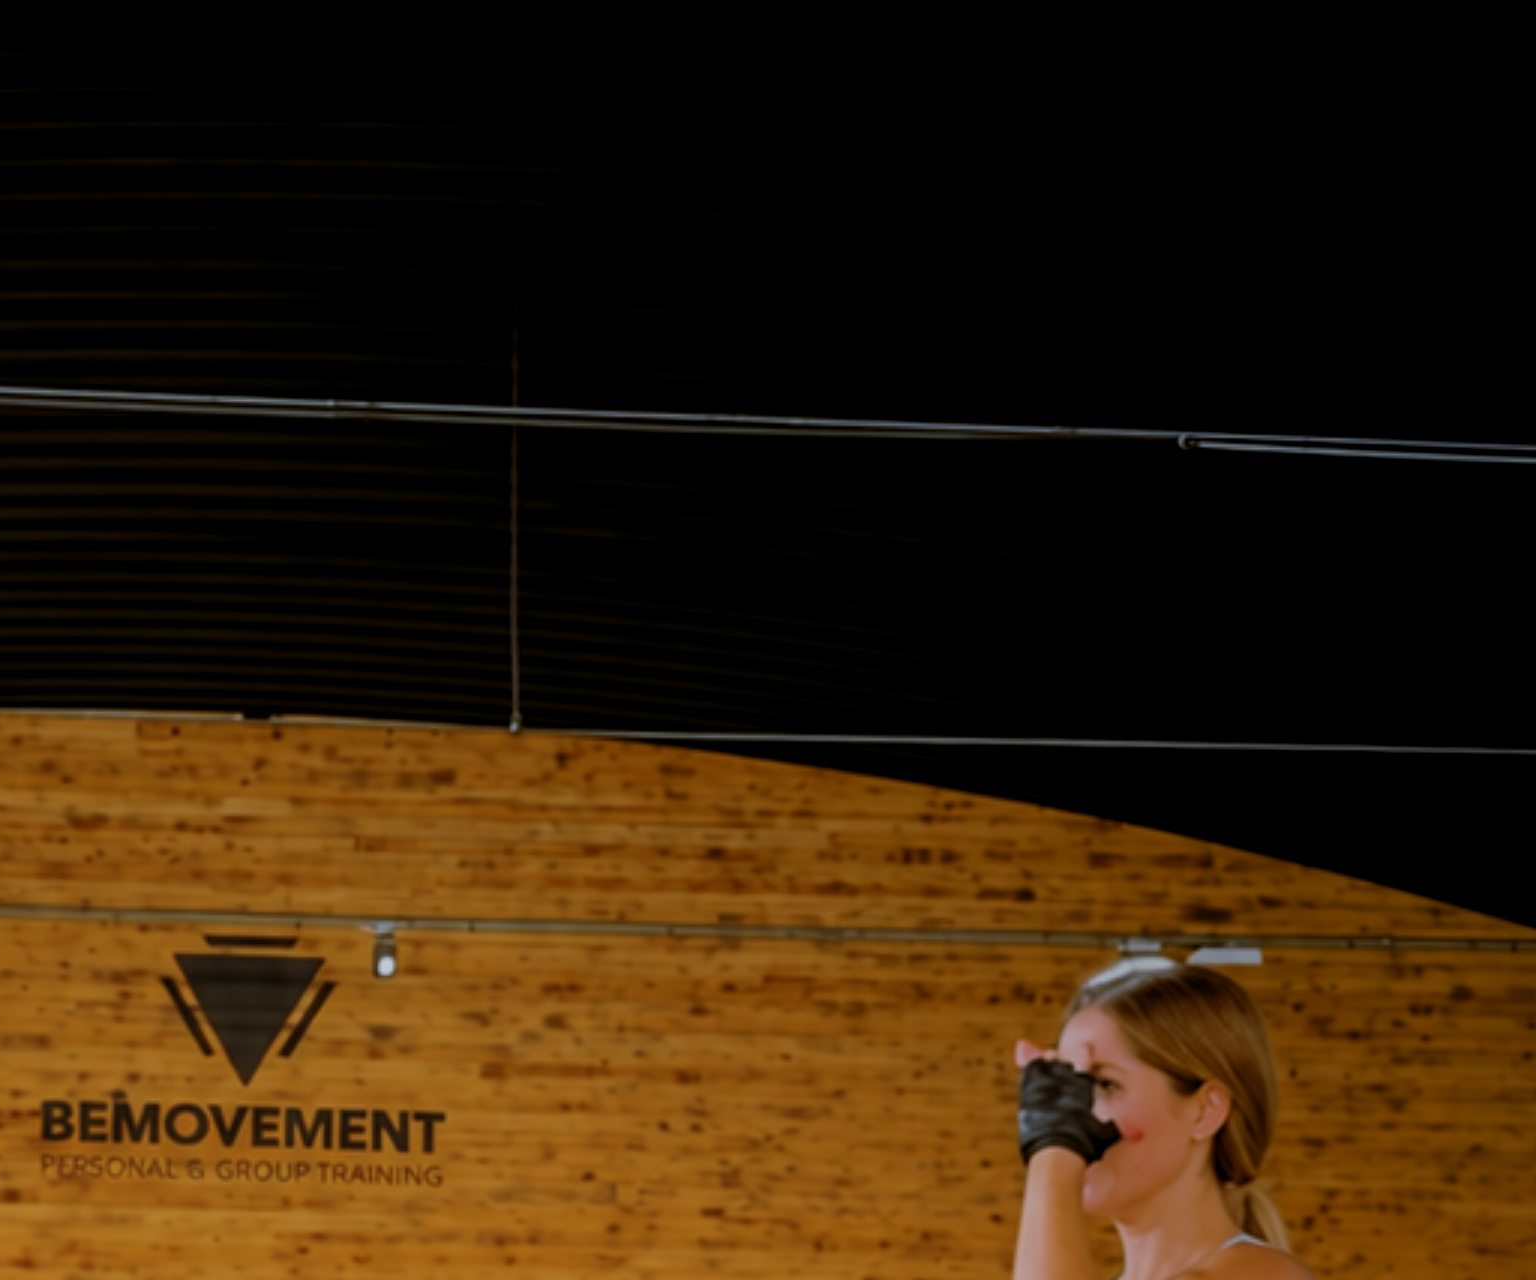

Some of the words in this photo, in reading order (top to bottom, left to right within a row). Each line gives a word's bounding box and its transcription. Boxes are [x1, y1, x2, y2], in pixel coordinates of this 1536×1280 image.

[41, 1100, 446, 1153] BEMOVEMENT
[41, 1153, 177, 1180] PERSONAL
[215, 1158, 311, 1183] GROUP
[317, 1160, 444, 1188] TRAINING
